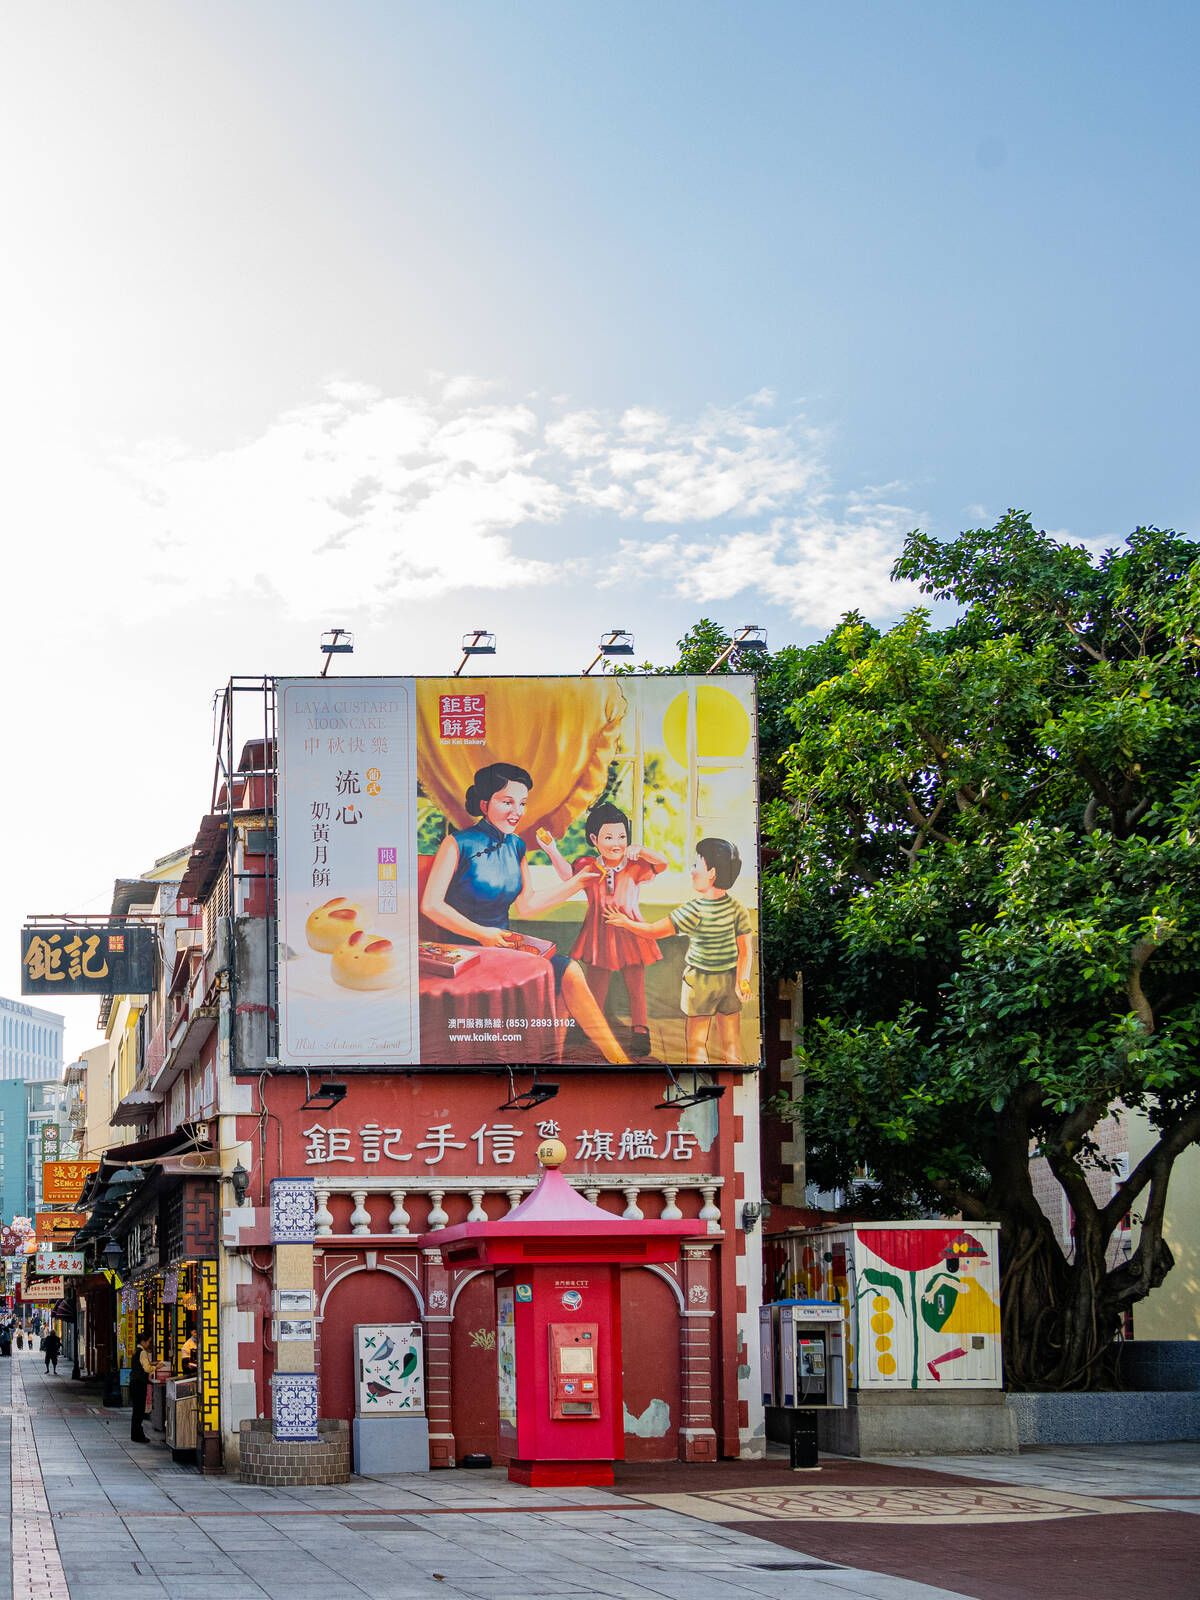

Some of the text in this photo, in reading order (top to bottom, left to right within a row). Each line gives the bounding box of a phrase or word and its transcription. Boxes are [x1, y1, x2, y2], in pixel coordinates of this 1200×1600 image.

[294, 701, 399, 714] LAVA CUSTARD
[441, 695, 484, 713] 鉅記
[307, 717, 386, 730] MOONCAKE
[441, 718, 484, 737] 餅家
[304, 736, 389, 755] 中秋快樂
[335, 769, 363, 825] 流心
[311, 800, 331, 888] 奶黃月餅
[23, 934, 109, 980] 鉅記
[506, 1018, 528, 1028] (853)
[530, 1018, 552, 1028] 2893
[554, 1018, 576, 1027] 8102
[303, 1123, 524, 1166] 鉅記手信
[575, 1127, 698, 1161] 旗艦店
[53, 1165, 99, 1179] 誠昌飯
[54, 1179, 74, 1187] SENG
[47, 1259, 83, 1270] 老酸奶
